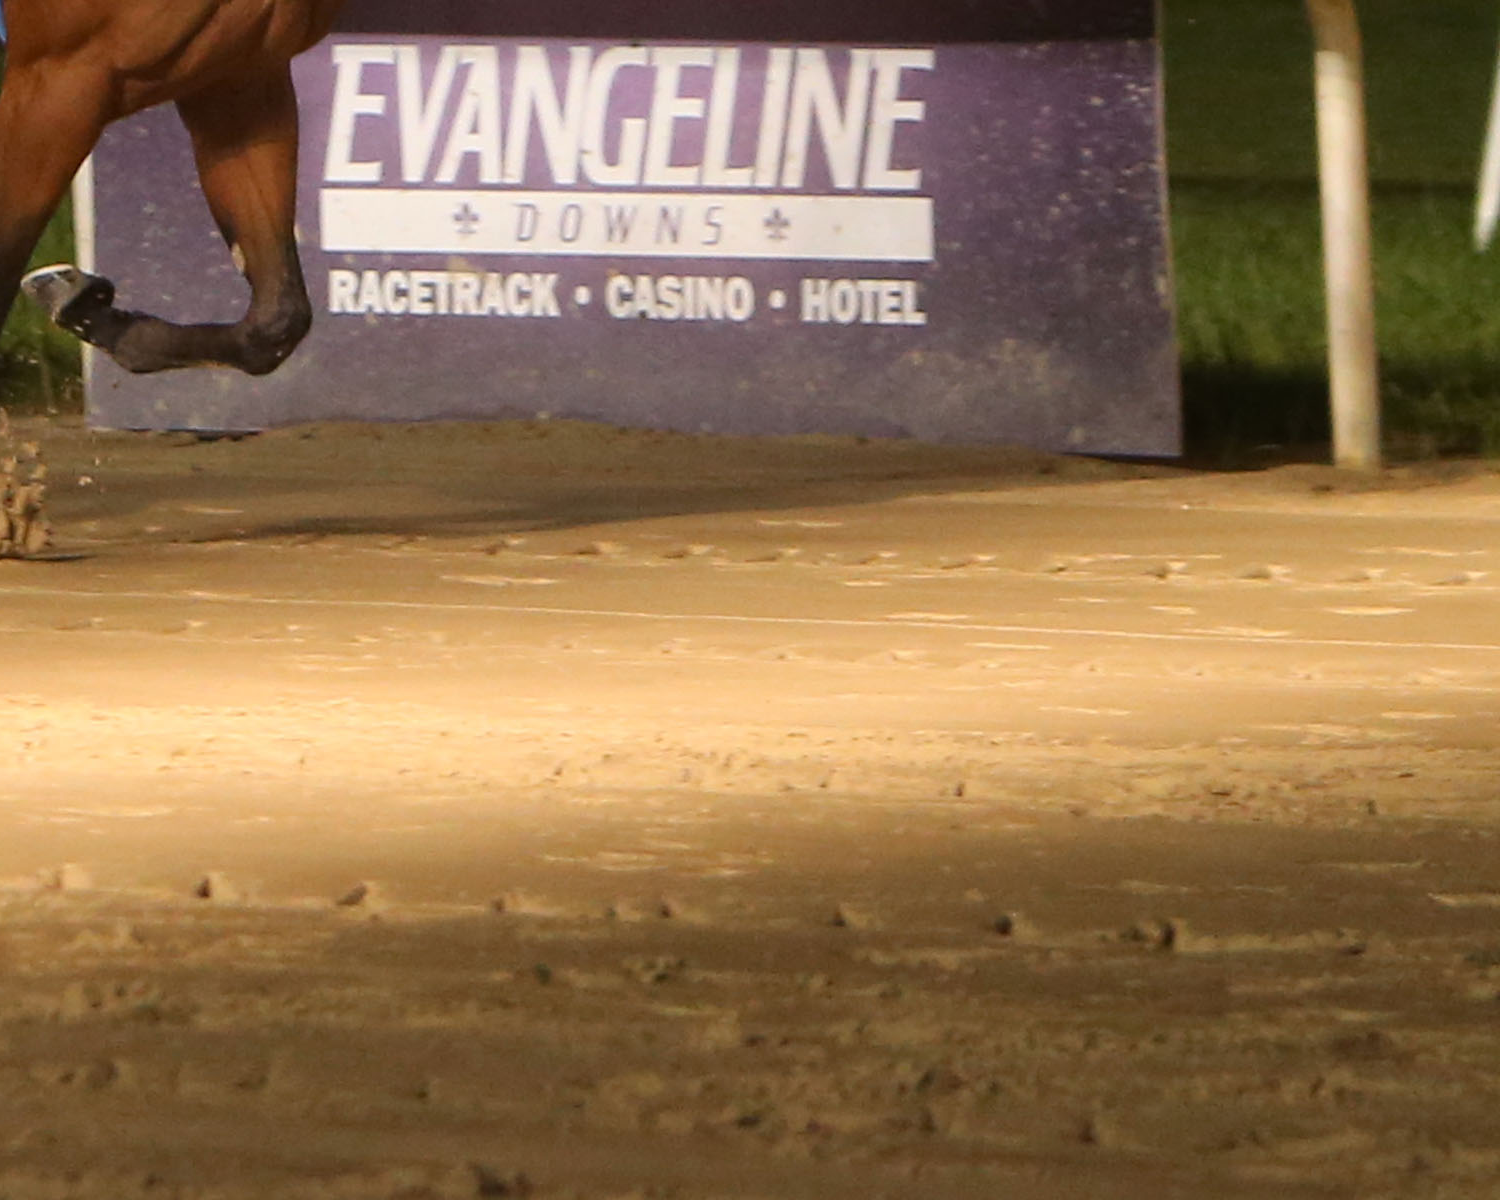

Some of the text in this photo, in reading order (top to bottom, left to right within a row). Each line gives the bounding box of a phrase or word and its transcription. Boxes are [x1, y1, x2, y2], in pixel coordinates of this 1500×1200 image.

[323, 43, 935, 190] EVANGELINE
[514, 202, 724, 245] DOWNS
[328, 269, 927, 325] RACETRACK CASINO HOTEL
